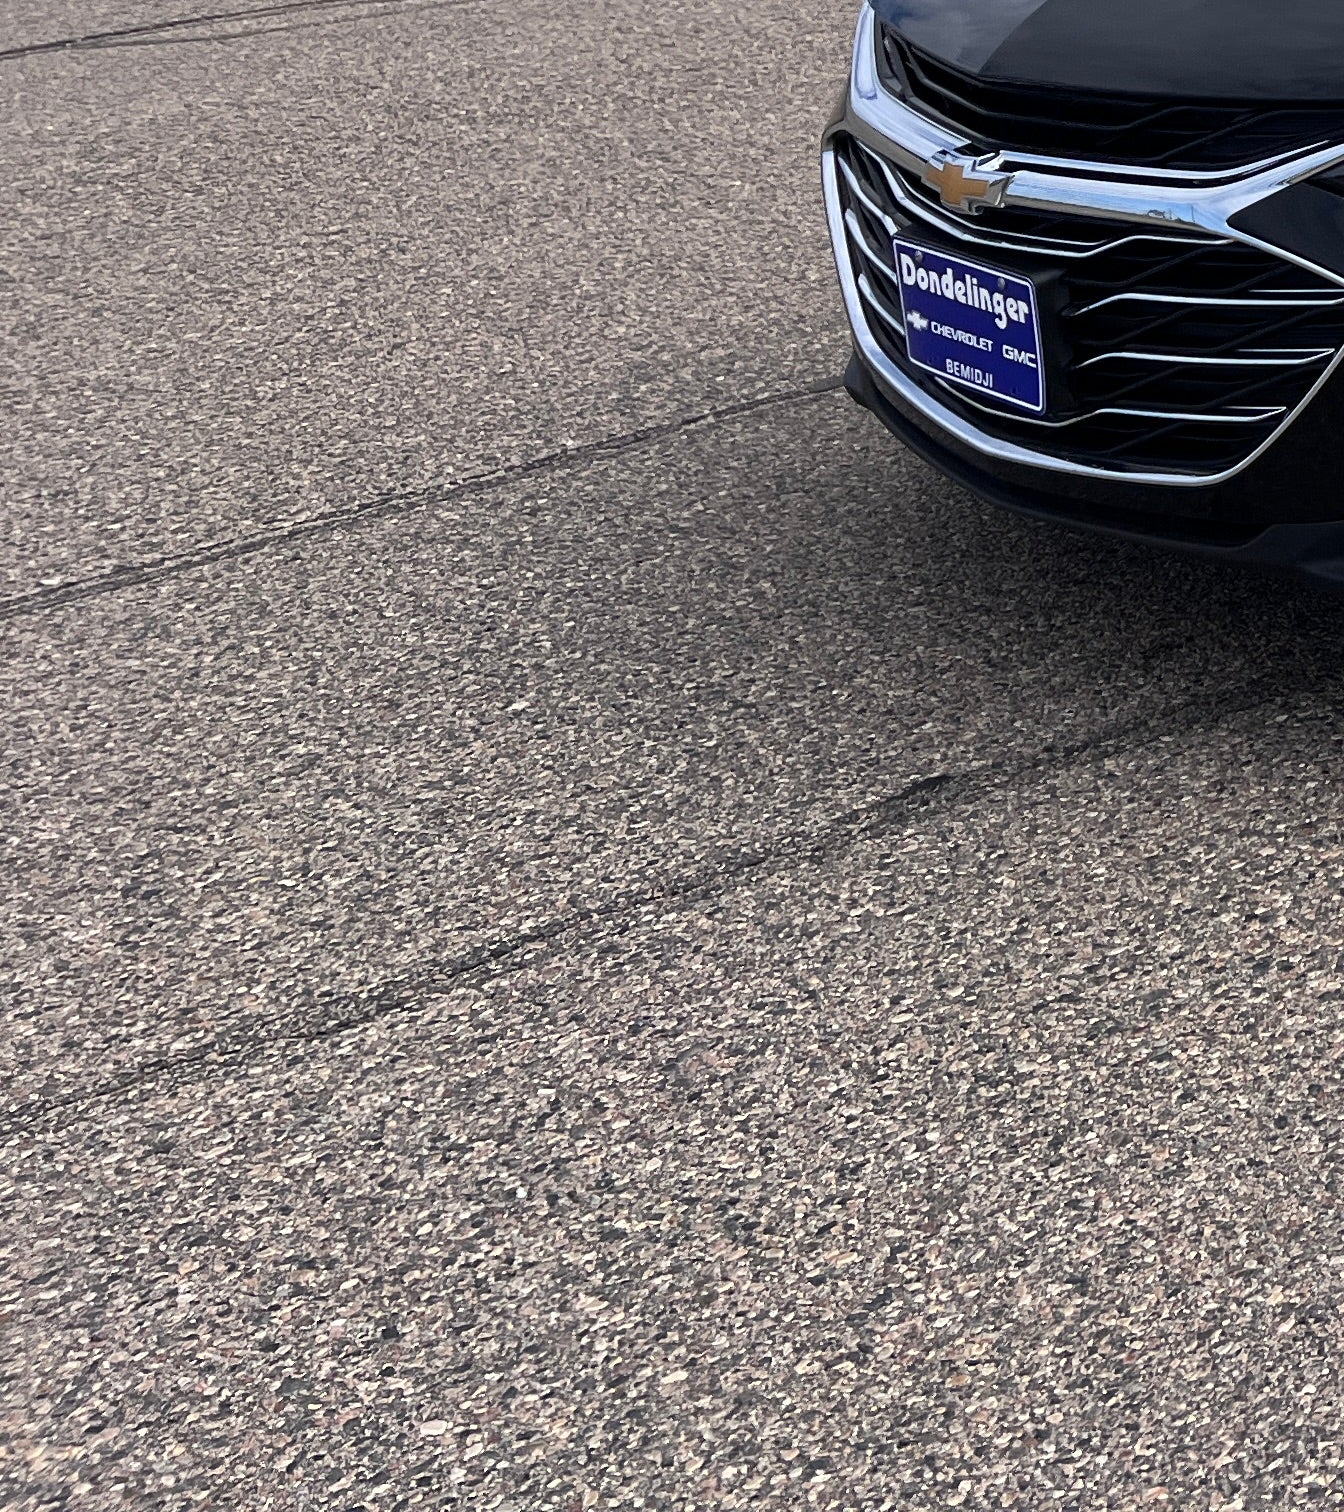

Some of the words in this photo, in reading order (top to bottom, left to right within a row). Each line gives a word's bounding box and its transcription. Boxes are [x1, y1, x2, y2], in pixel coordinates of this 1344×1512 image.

[900, 253, 1029, 330] Dondelinger
[930, 321, 993, 352] CHEVROLET
[1002, 344, 1037, 368] GMC
[946, 358, 993, 388] BEMIDJI
